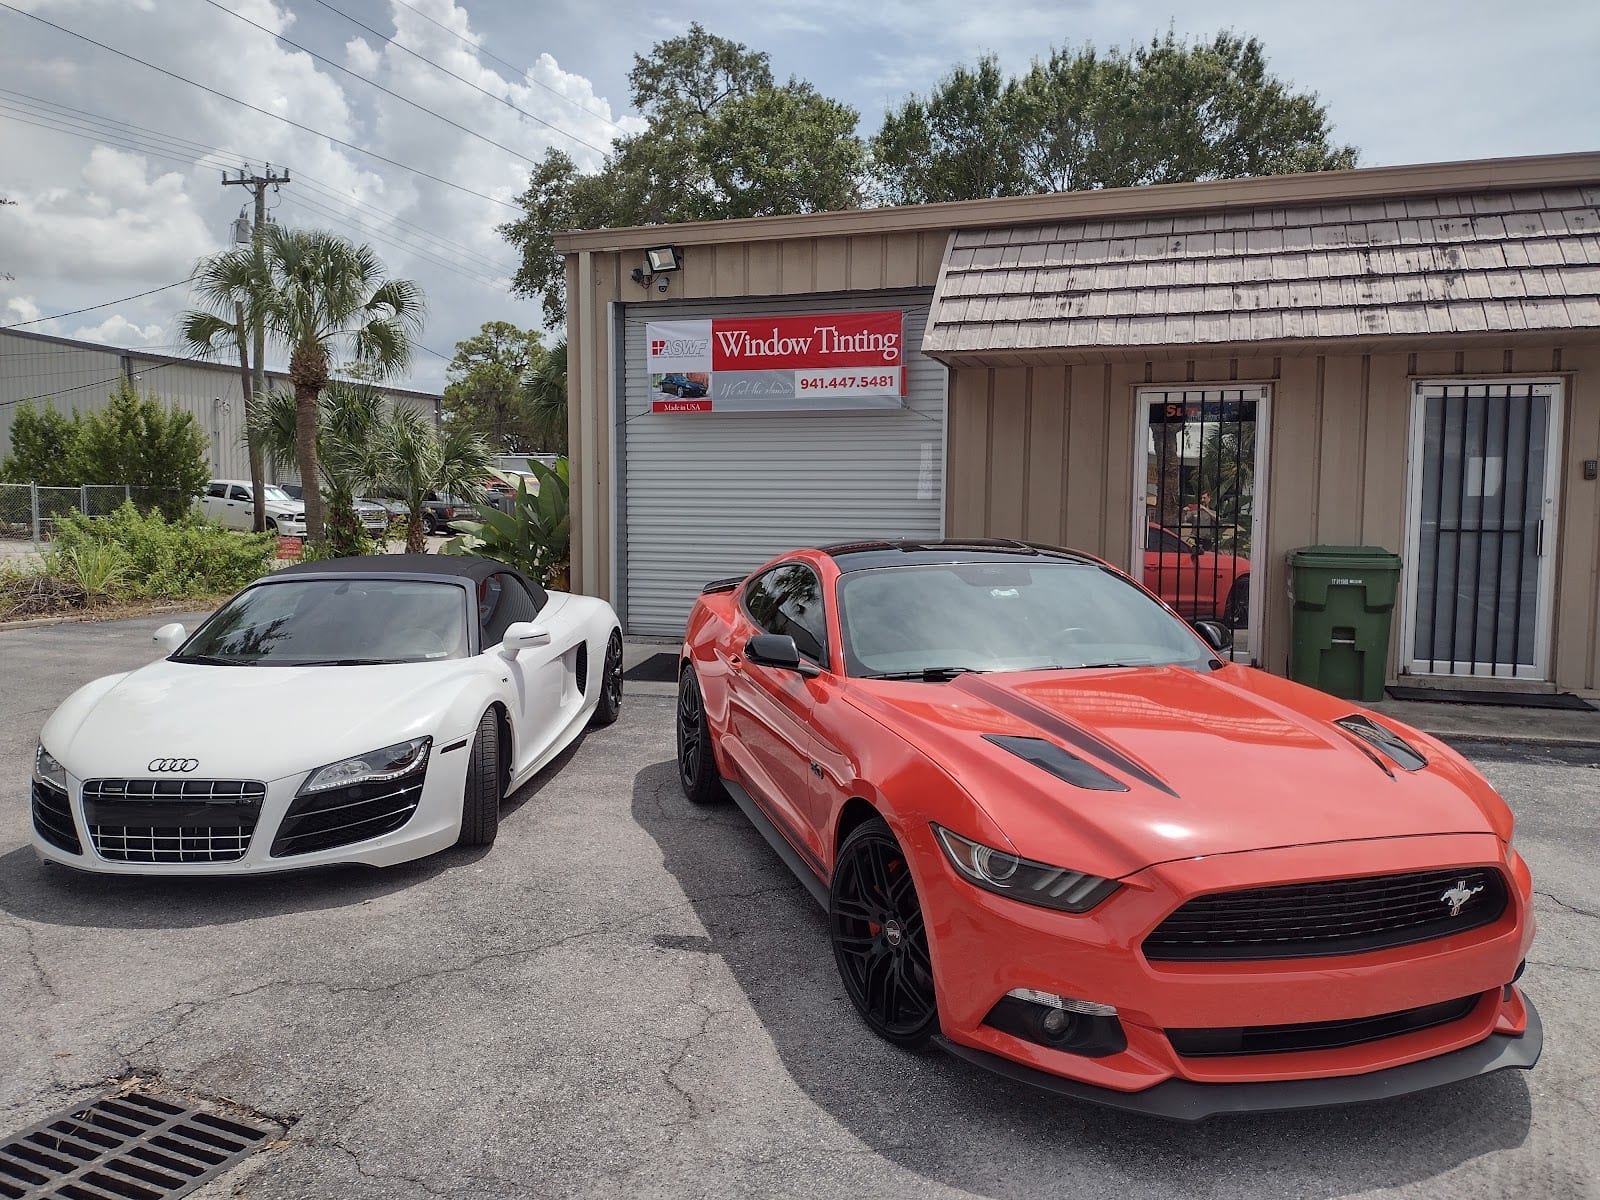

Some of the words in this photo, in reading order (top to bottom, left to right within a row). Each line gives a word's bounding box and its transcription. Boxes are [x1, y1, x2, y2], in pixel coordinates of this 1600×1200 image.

[660, 339, 708, 355] ASWF
[716, 328, 812, 357] Window
[814, 326, 898, 360] Tinting
[800, 375, 894, 390] 941.447.5481
[664, 403, 679, 411] Made
[679, 403, 685, 411] in
[686, 403, 700, 411] USA
